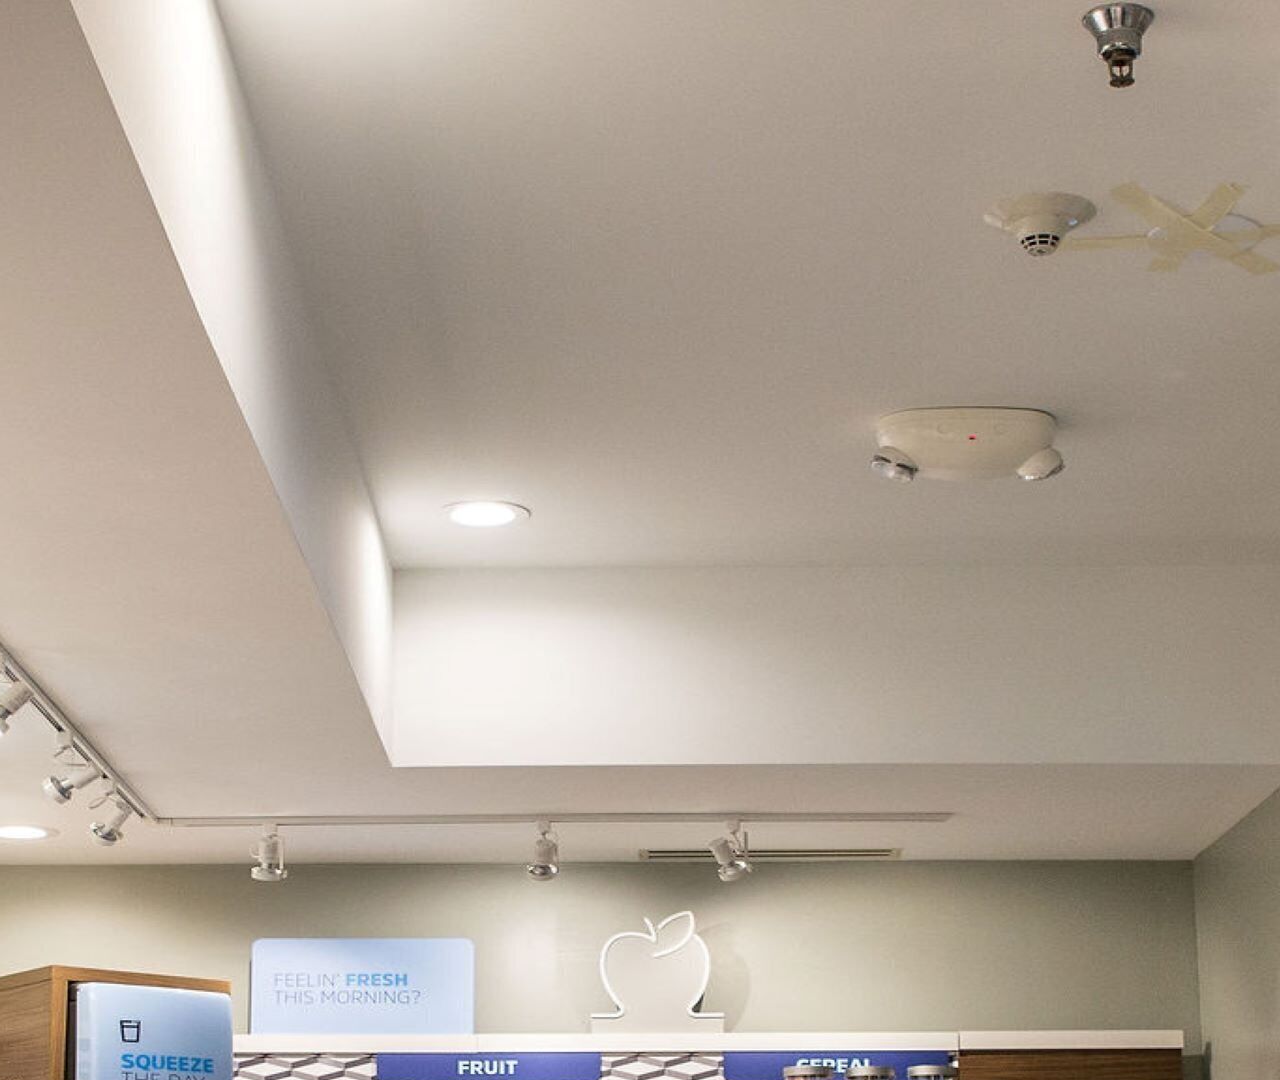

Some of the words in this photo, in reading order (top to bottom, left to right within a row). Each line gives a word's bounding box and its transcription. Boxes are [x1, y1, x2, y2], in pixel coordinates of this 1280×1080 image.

[346, 972, 408, 987] FRESH
[275, 990, 314, 1006] THIS
[320, 989, 421, 1006] MORNING?
[121, 1053, 214, 1073] SQUEEZE
[458, 1060, 518, 1075] FRUIT
